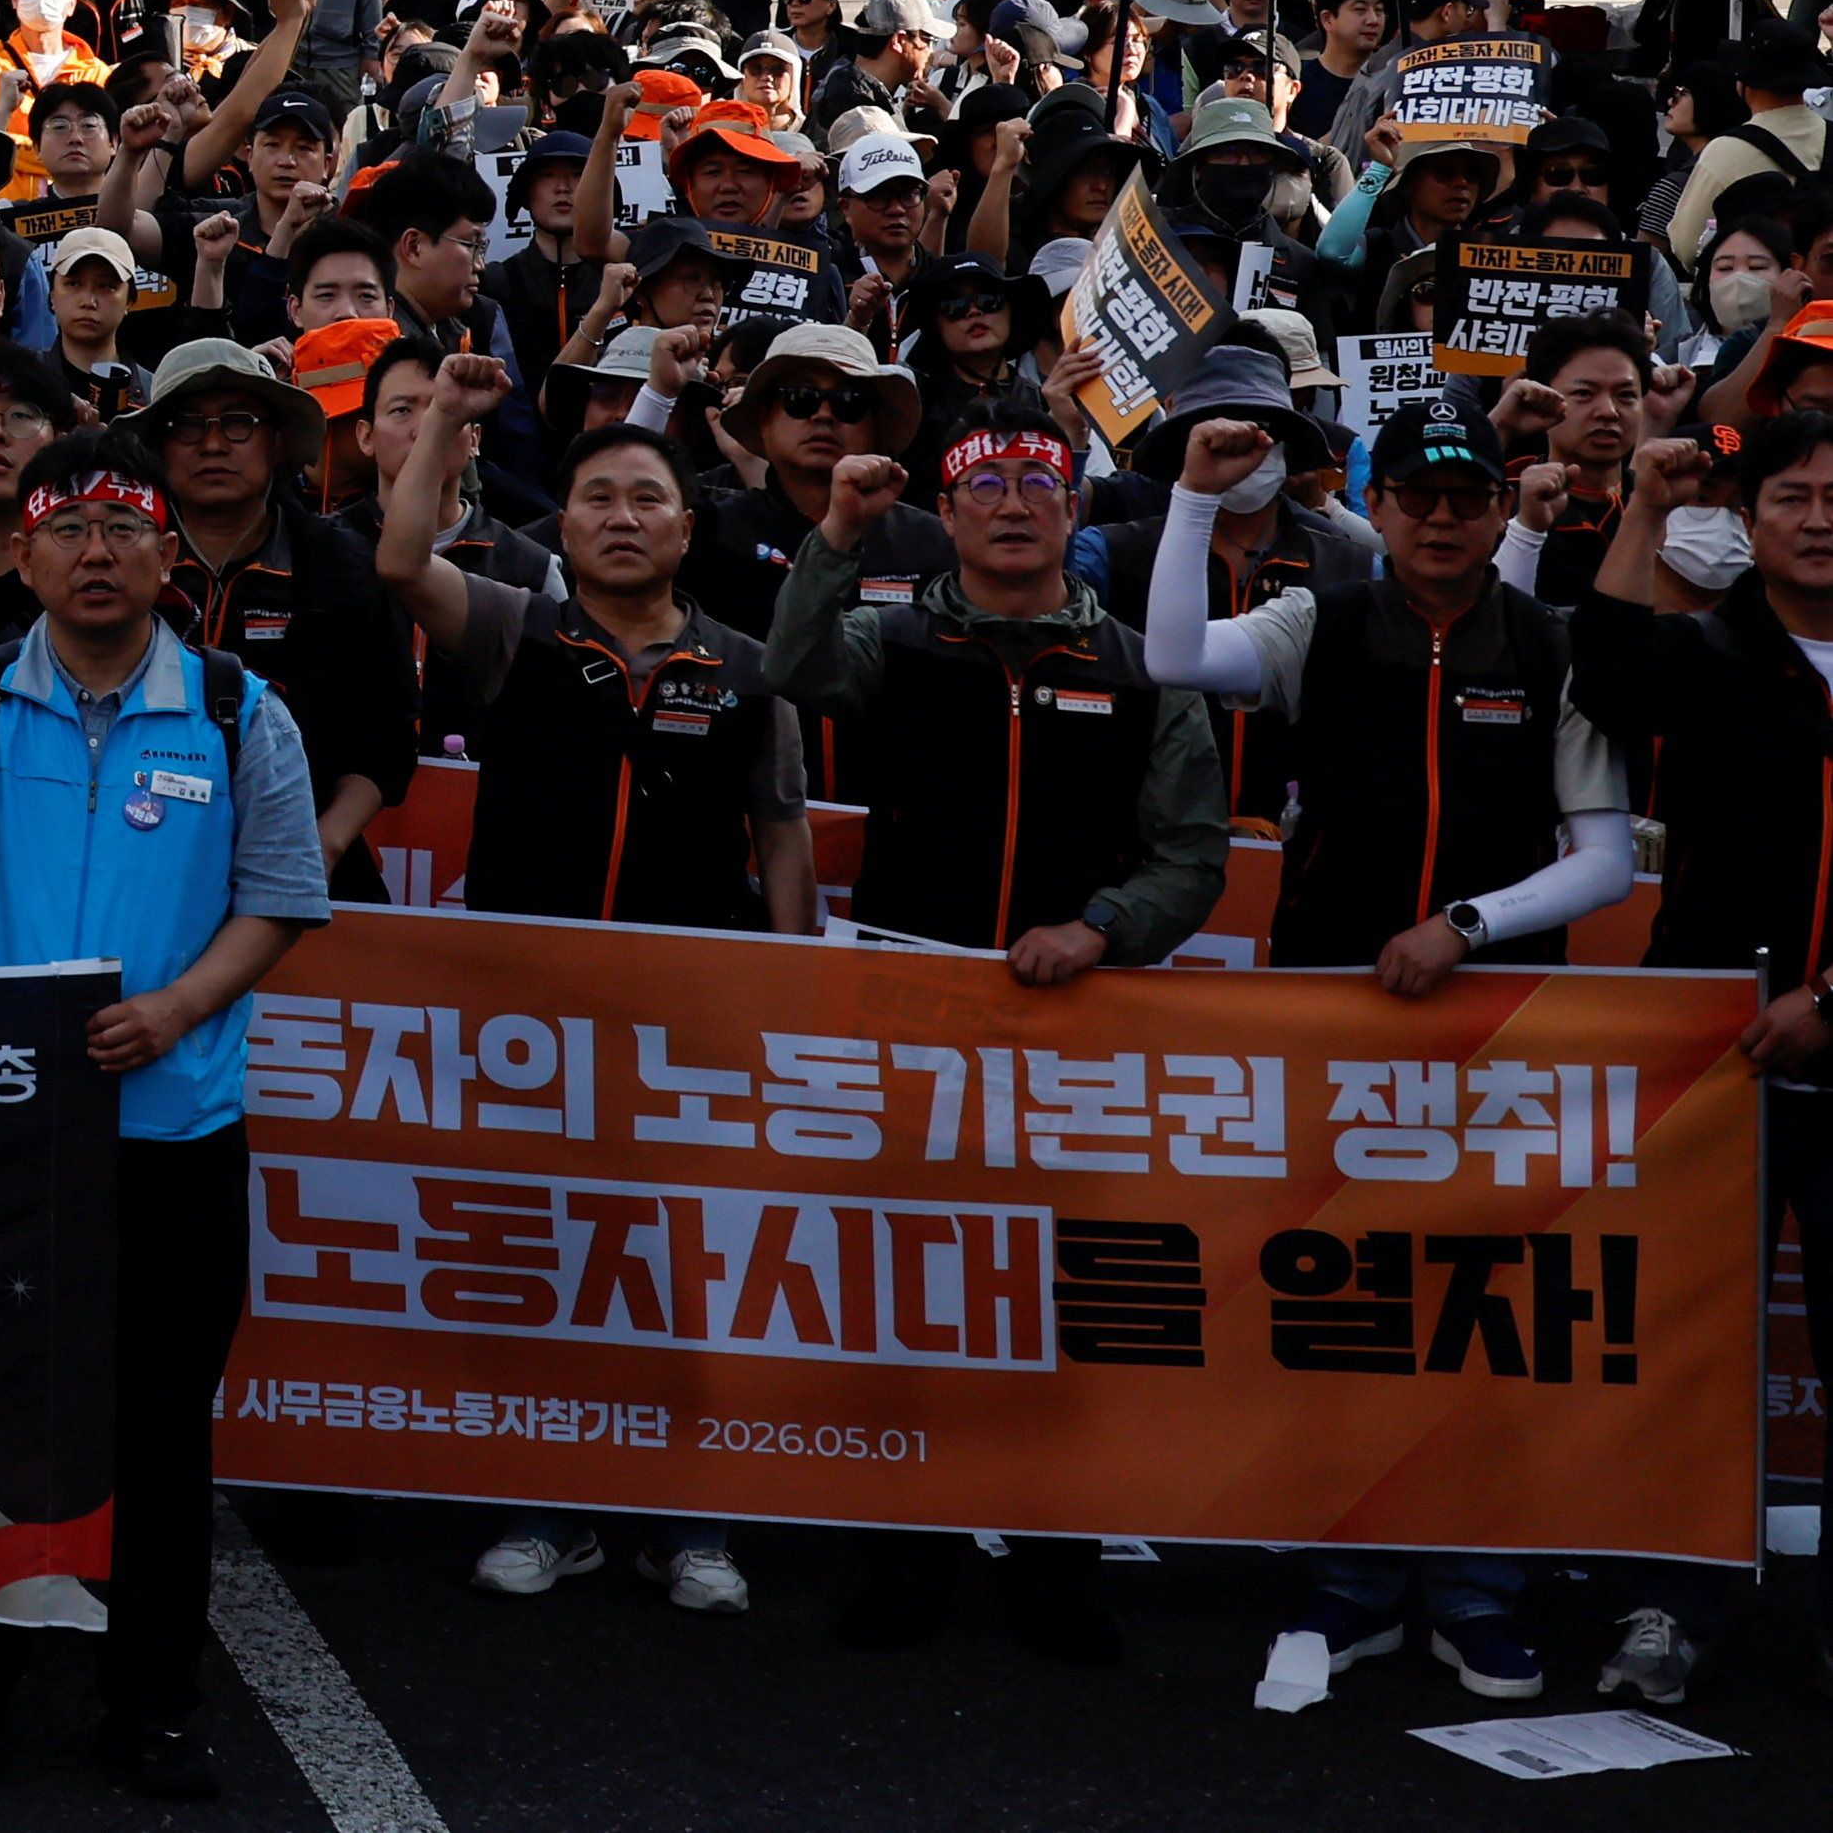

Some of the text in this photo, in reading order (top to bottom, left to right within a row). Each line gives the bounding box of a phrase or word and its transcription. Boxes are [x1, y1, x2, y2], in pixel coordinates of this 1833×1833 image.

[1402, 40, 1535, 68] 가자! 노동자 시대!
[859, 148, 916, 172] Titleist
[774, 241, 813, 268] 시대!
[1466, 245, 1624, 277] 가자! 노동자 시대!
[1018, 431, 1064, 468] 투쟁
[243, 994, 1639, 1190] 동자의 노동기본권 쟁취!
[260, 1164, 1642, 1385] 노동자시대를 열자!
[236, 1376, 931, 1465] 사무금융노동자참가단 2026.05.01
